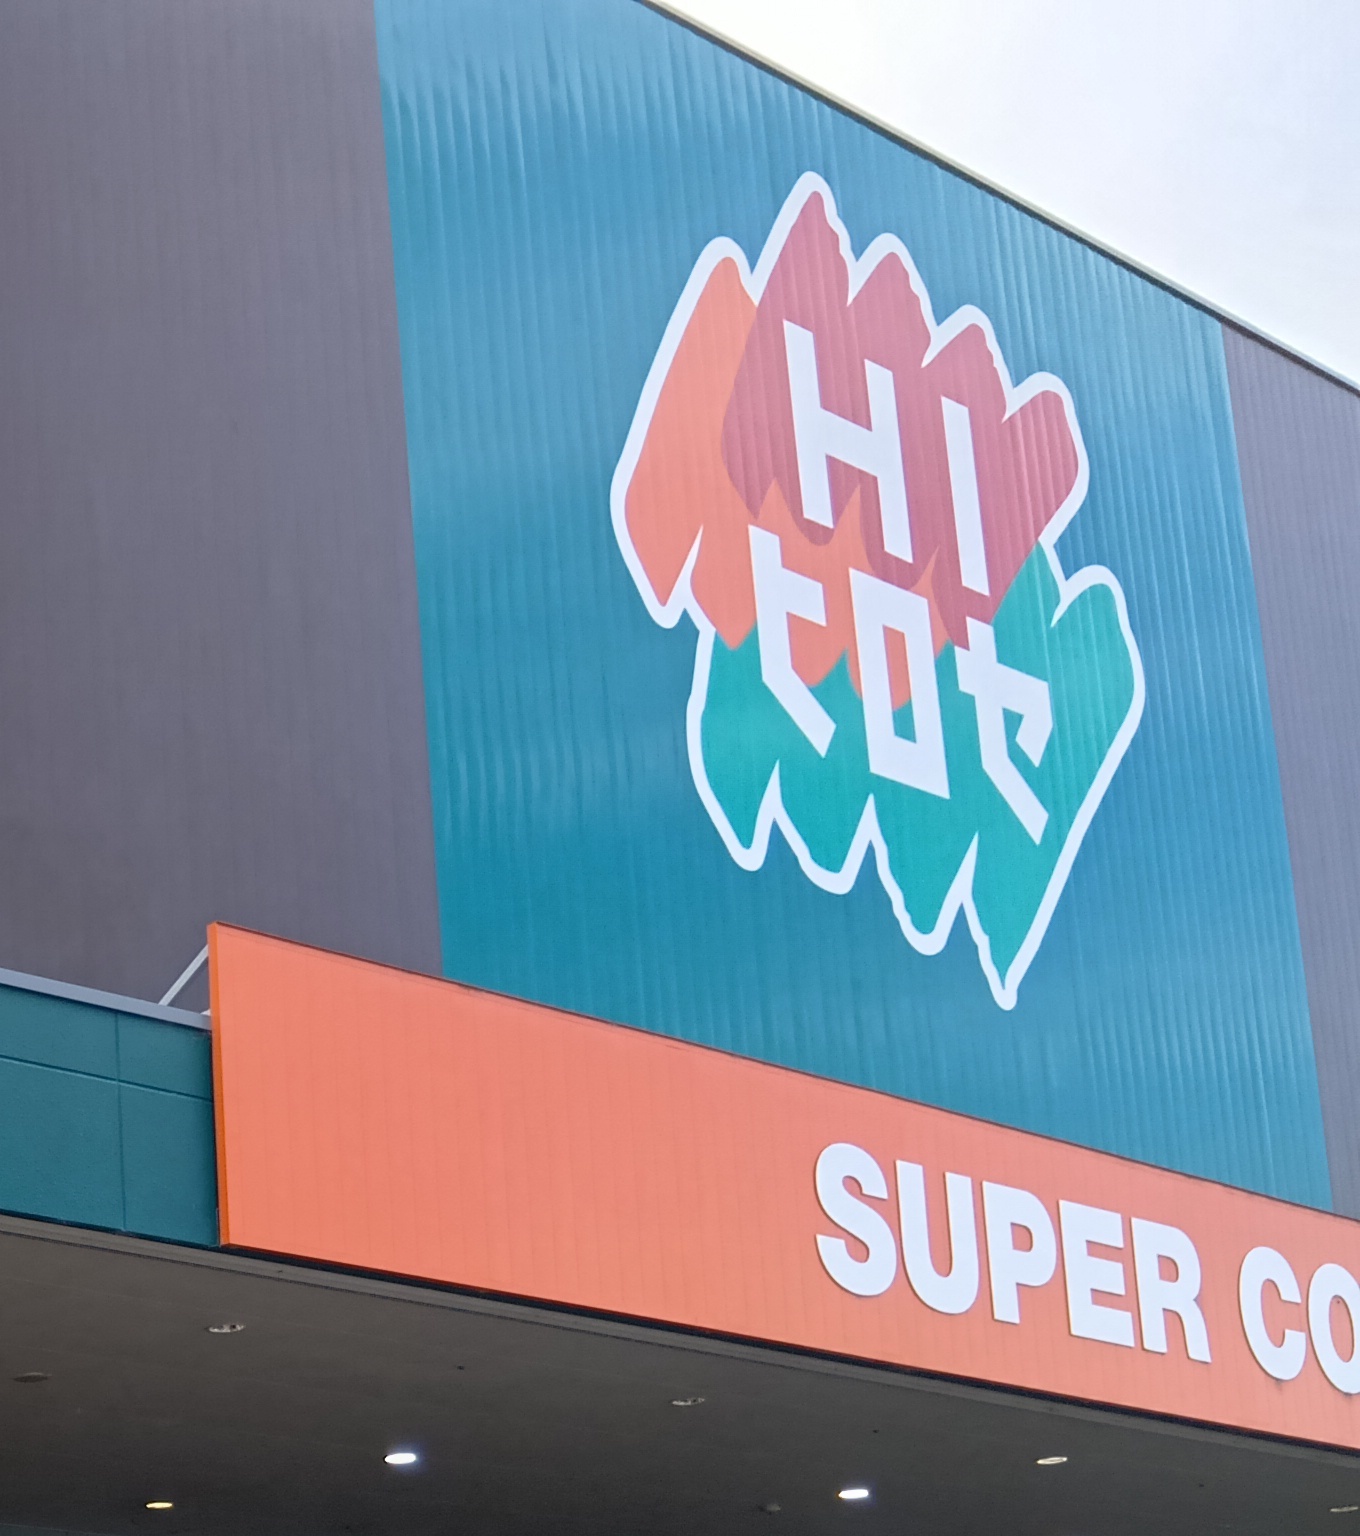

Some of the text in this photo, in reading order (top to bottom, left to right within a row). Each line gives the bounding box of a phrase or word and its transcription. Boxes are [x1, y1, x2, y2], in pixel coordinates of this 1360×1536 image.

[784, 319, 991, 598] HI
[748, 523, 1056, 846] ヒロセ
[814, 1142, 1212, 1364] SUPER
